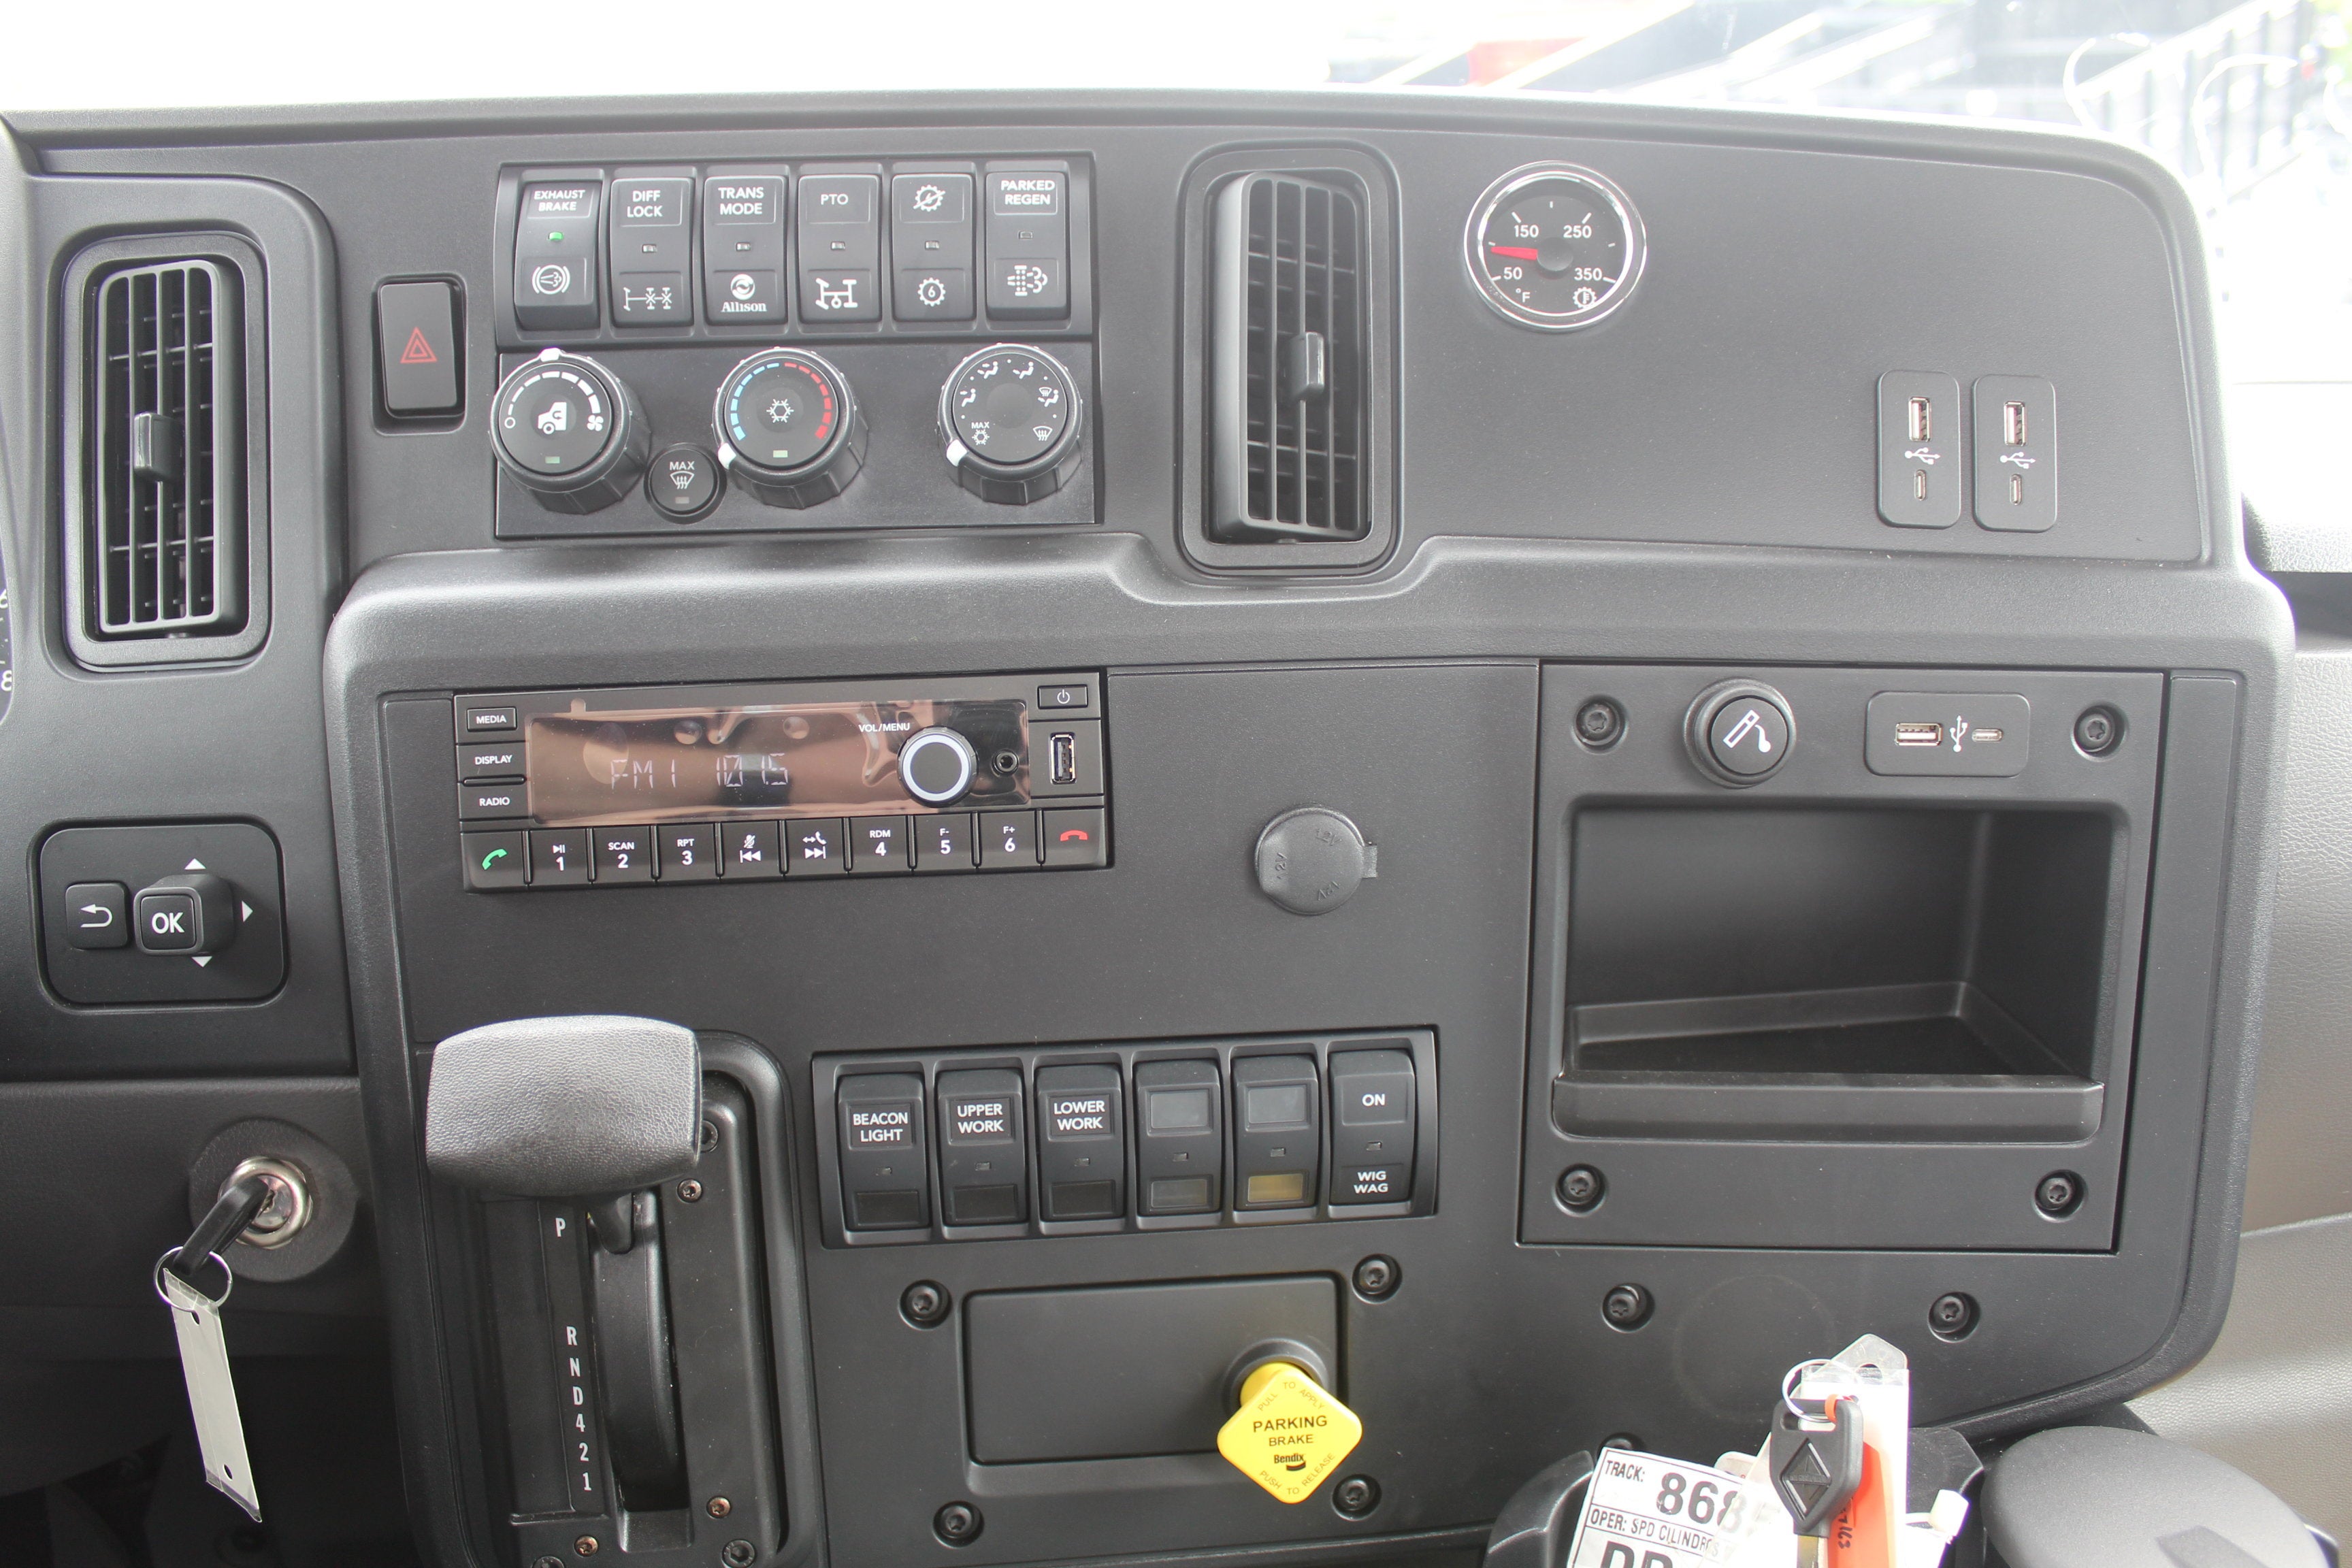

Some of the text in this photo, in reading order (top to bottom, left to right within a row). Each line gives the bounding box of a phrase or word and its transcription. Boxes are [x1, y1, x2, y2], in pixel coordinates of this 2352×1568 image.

[717, 186, 764, 199] TRANS
[1000, 180, 1056, 191] PARKED
[534, 189, 586, 201] EXHAUST
[632, 190, 661, 202] DIFF
[820, 193, 849, 206] PTO
[1004, 194, 1051, 206] REGEN
[538, 201, 578, 212] BRAKE
[626, 205, 663, 218] LOCK
[719, 202, 763, 215] MODE
[1514, 224, 1540, 238] 150
[1563, 225, 1592, 239] 250
[1503, 266, 1523, 280] 50
[1573, 267, 1603, 282] 350
[928, 285, 935, 297] 6
[721, 301, 768, 313] Allison
[970, 421, 990, 429] MAX
[669, 461, 696, 471] MAX
[476, 714, 507, 725] MEDIA
[858, 722, 911, 733] VOL/MENU
[474, 754, 513, 766] DISPLAY
[478, 796, 510, 807] RADIO
[869, 829, 891, 839] RDM
[939, 828, 950, 837] F-
[1002, 826, 1015, 835] F+
[607, 841, 635, 851] SCAN
[676, 838, 695, 849] RPT
[875, 841, 886, 857] 4
[940, 839, 951, 855] 5
[1004, 837, 1016, 853] 6
[555, 856, 565, 872] 1
[617, 853, 629, 869] 2
[681, 850, 693, 866] 3
[151, 912, 185, 934] OK
[1362, 1093, 1386, 1107] ON
[957, 1102, 1004, 1117] UPPER
[1053, 1100, 1106, 1115] LOWER
[852, 1112, 909, 1126] BEACON
[1056, 1116, 1103, 1131] WORK
[958, 1120, 1004, 1134] WORK
[860, 1128, 904, 1143] LIGHT
[1357, 1170, 1387, 1182] WIG
[1353, 1182, 1389, 1194] WAG
[555, 1217, 566, 1238] P
[566, 1326, 578, 1346] R
[569, 1357, 581, 1377] N
[572, 1386, 584, 1406] D
[1256, 1381, 1326, 1412] PULL TO APPLY
[575, 1413, 586, 1433] 4
[1253, 1415, 1328, 1433] PARKING
[1269, 1434, 1314, 1447] BRAKE
[578, 1442, 589, 1462] 2
[1274, 1452, 1305, 1464] Bendix
[1259, 1452, 1335, 1495] PUSH TO RELEASE
[1604, 1460, 1646, 1483] TRACK:
[583, 1471, 592, 1492] 1
[1590, 1507, 1627, 1532] OPER:
[1631, 1517, 1655, 1537] SPD
